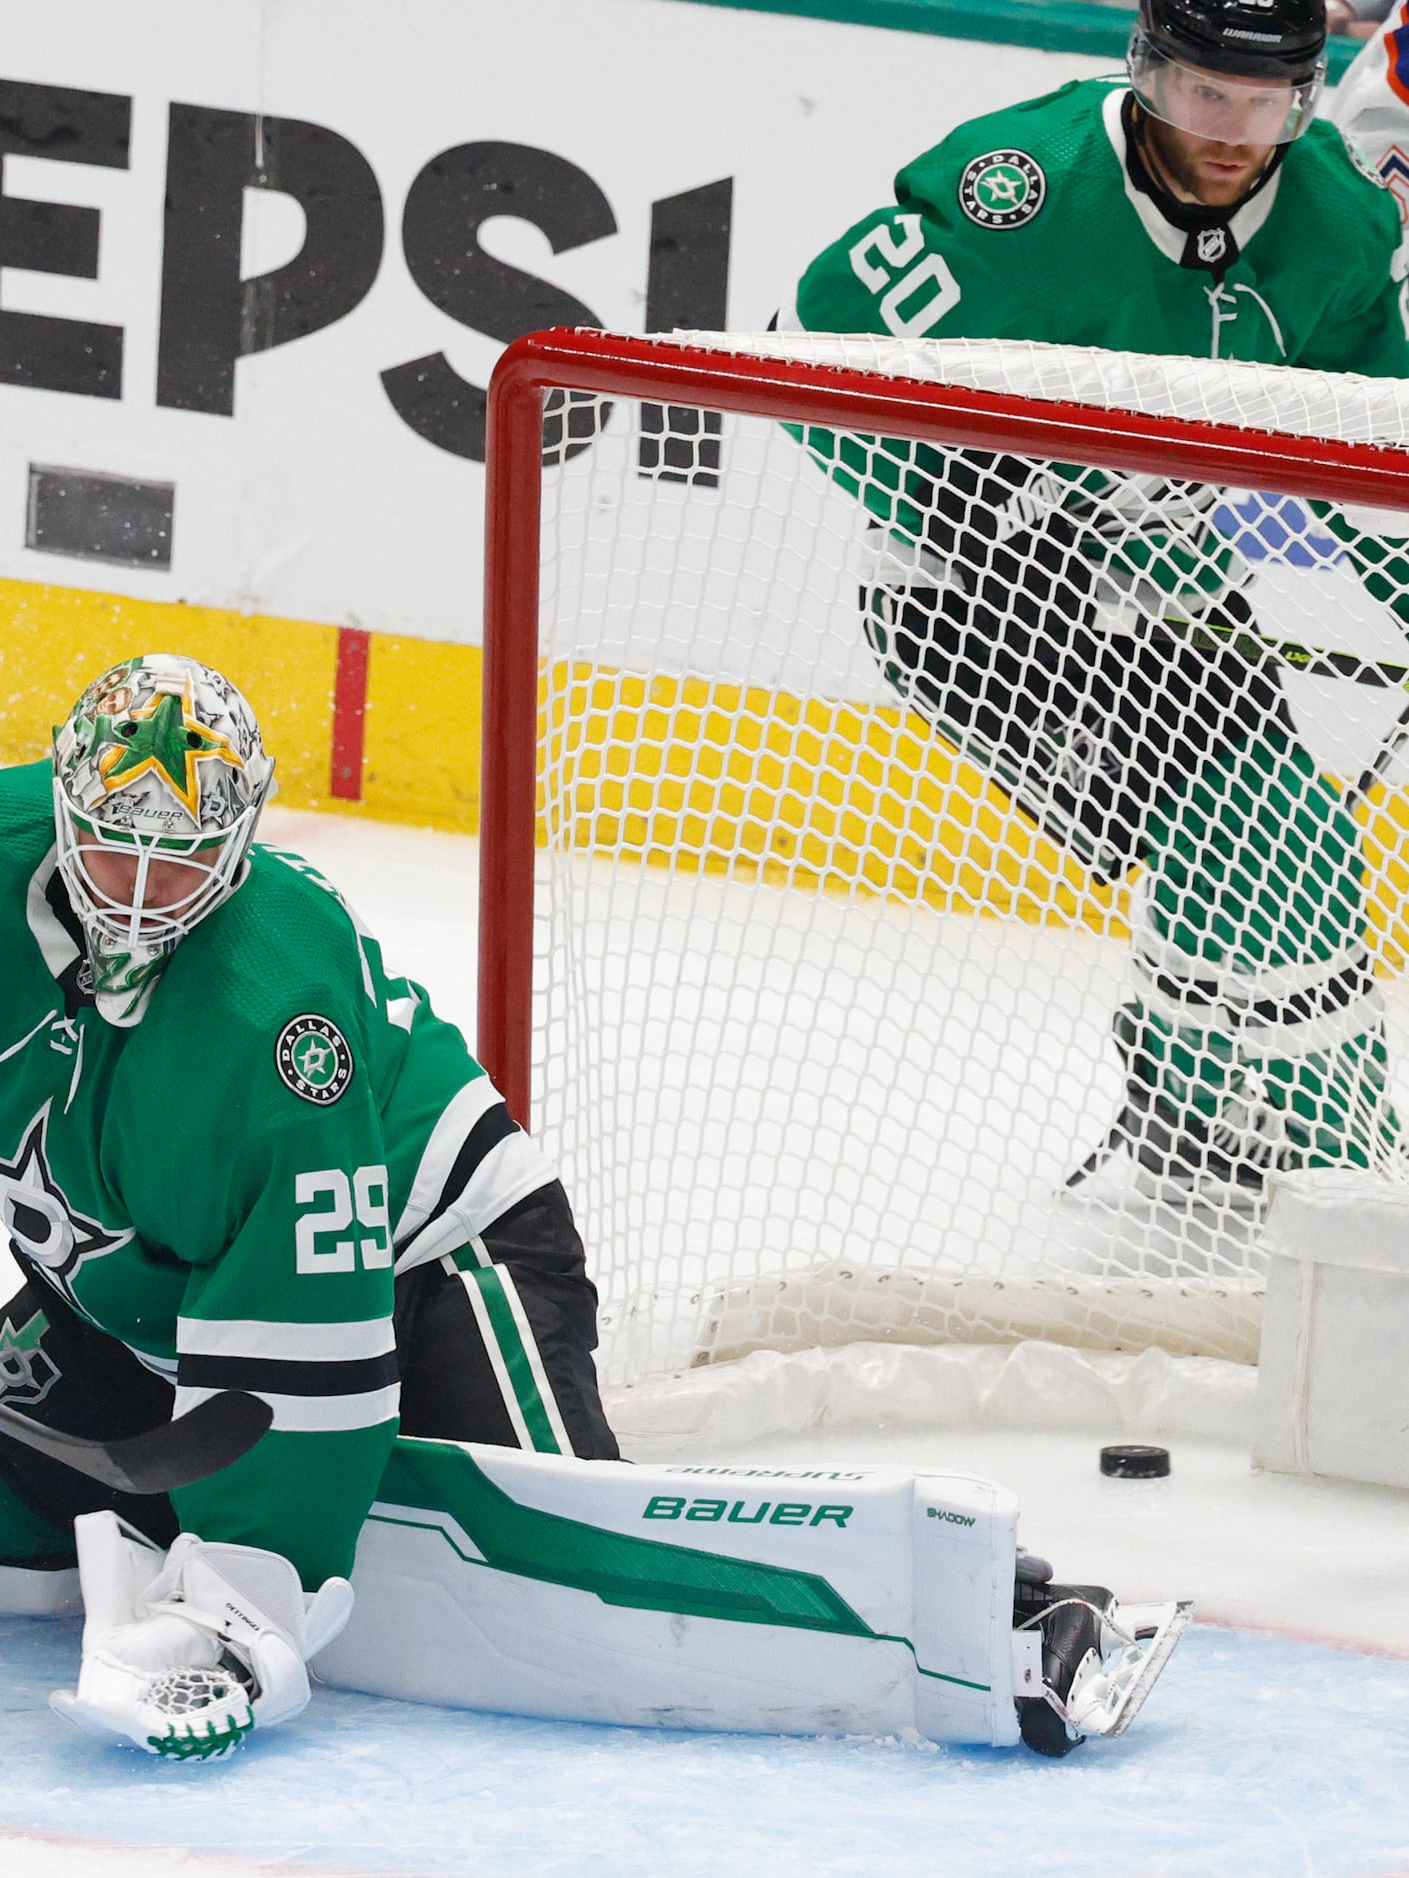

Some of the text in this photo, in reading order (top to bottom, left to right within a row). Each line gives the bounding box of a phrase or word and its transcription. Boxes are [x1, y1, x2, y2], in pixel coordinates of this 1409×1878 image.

[1222, 27, 1283, 43] WARRIOR
[964, 170, 1004, 225] STARS
[991, 154, 1039, 214] DALLAS
[848, 213, 962, 338] 20
[281, 1019, 343, 1063] DALLAS
[294, 1066, 348, 1101] STARS
[294, 1164, 393, 1275] 29
[641, 1496, 855, 1529] BAUER
[926, 1507, 977, 1528] SHADOW
